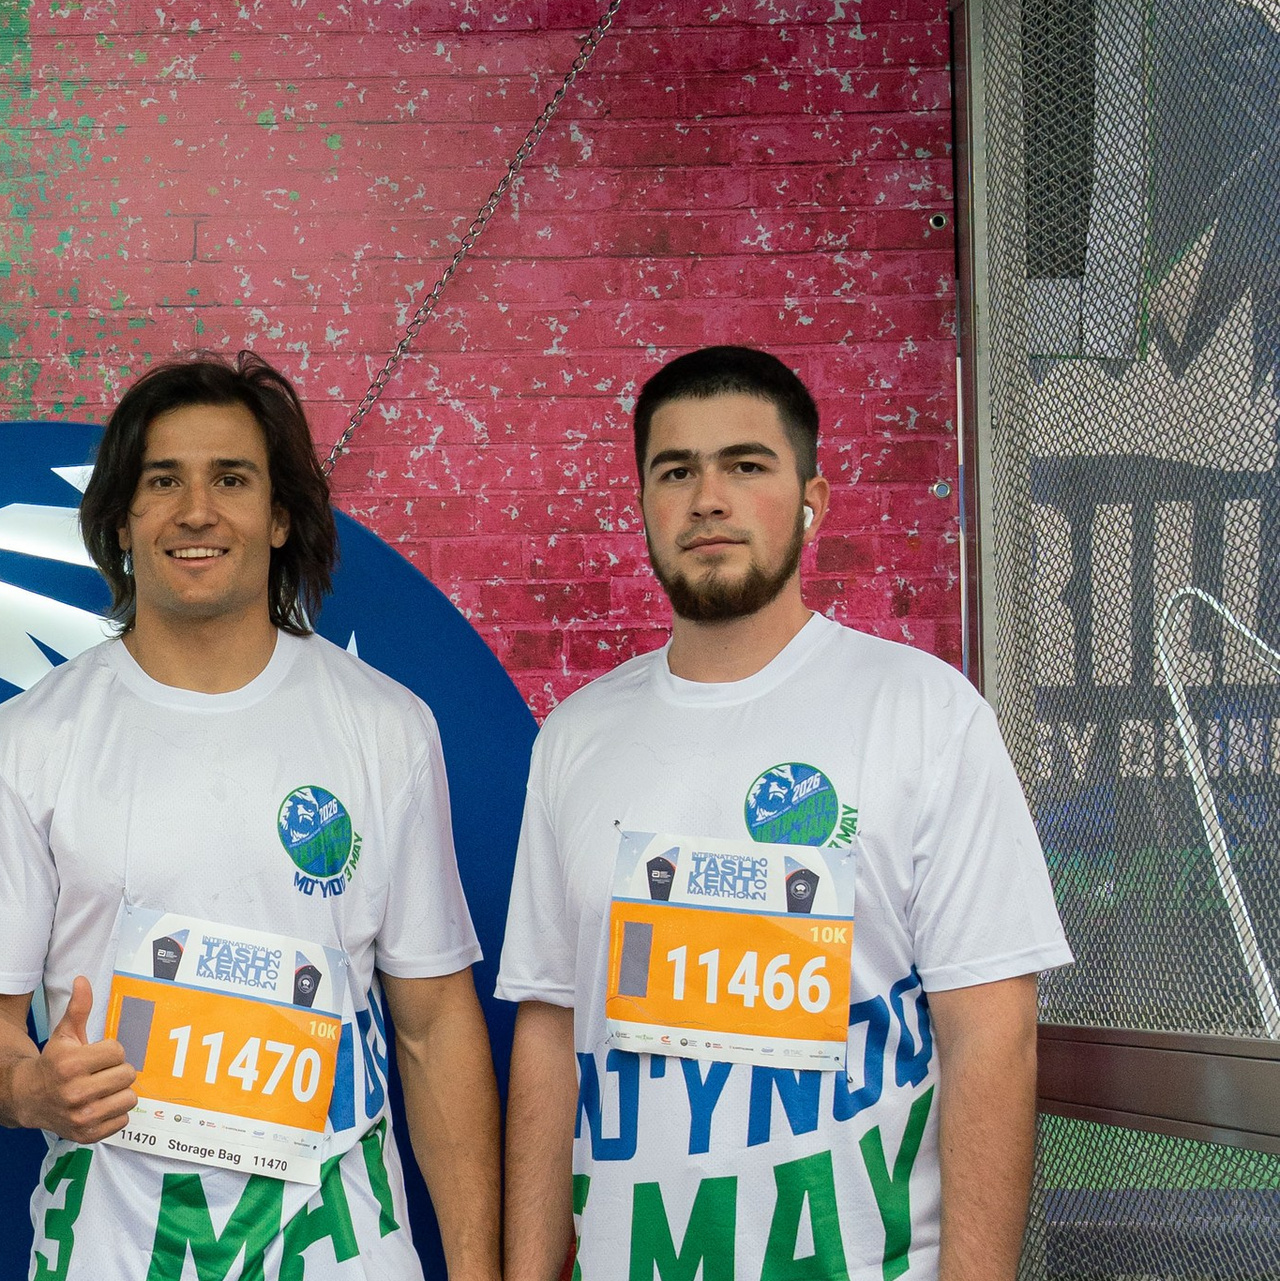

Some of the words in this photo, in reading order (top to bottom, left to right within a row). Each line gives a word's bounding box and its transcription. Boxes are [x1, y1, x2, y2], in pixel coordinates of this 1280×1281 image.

[791, 773, 821, 803] 2026
[835, 803, 858, 844] MAY
[349, 831, 363, 870] MAY
[691, 851, 754, 863] INTERNATIONAL
[687, 872, 755, 894] KENT
[692, 857, 757, 881] TASH
[753, 857, 768, 902] 2026
[686, 886, 758, 900] MARATHON
[202, 934, 270, 953] INTERNATIONAL
[810, 926, 847, 944] 10K
[196, 954, 266, 982] KENT
[201, 938, 272, 970] TASH
[195, 969, 269, 989] MARATHON
[264, 948, 282, 991] 2026
[667, 945, 831, 1014] 11466
[309, 1020, 337, 1041] 10K
[169, 1025, 321, 1103] 11470
[120, 1129, 157, 1147] 11470
[167, 1138, 215, 1158] Storage
[218, 1149, 242, 1165] Bag
[253, 1155, 288, 1172] 11470
